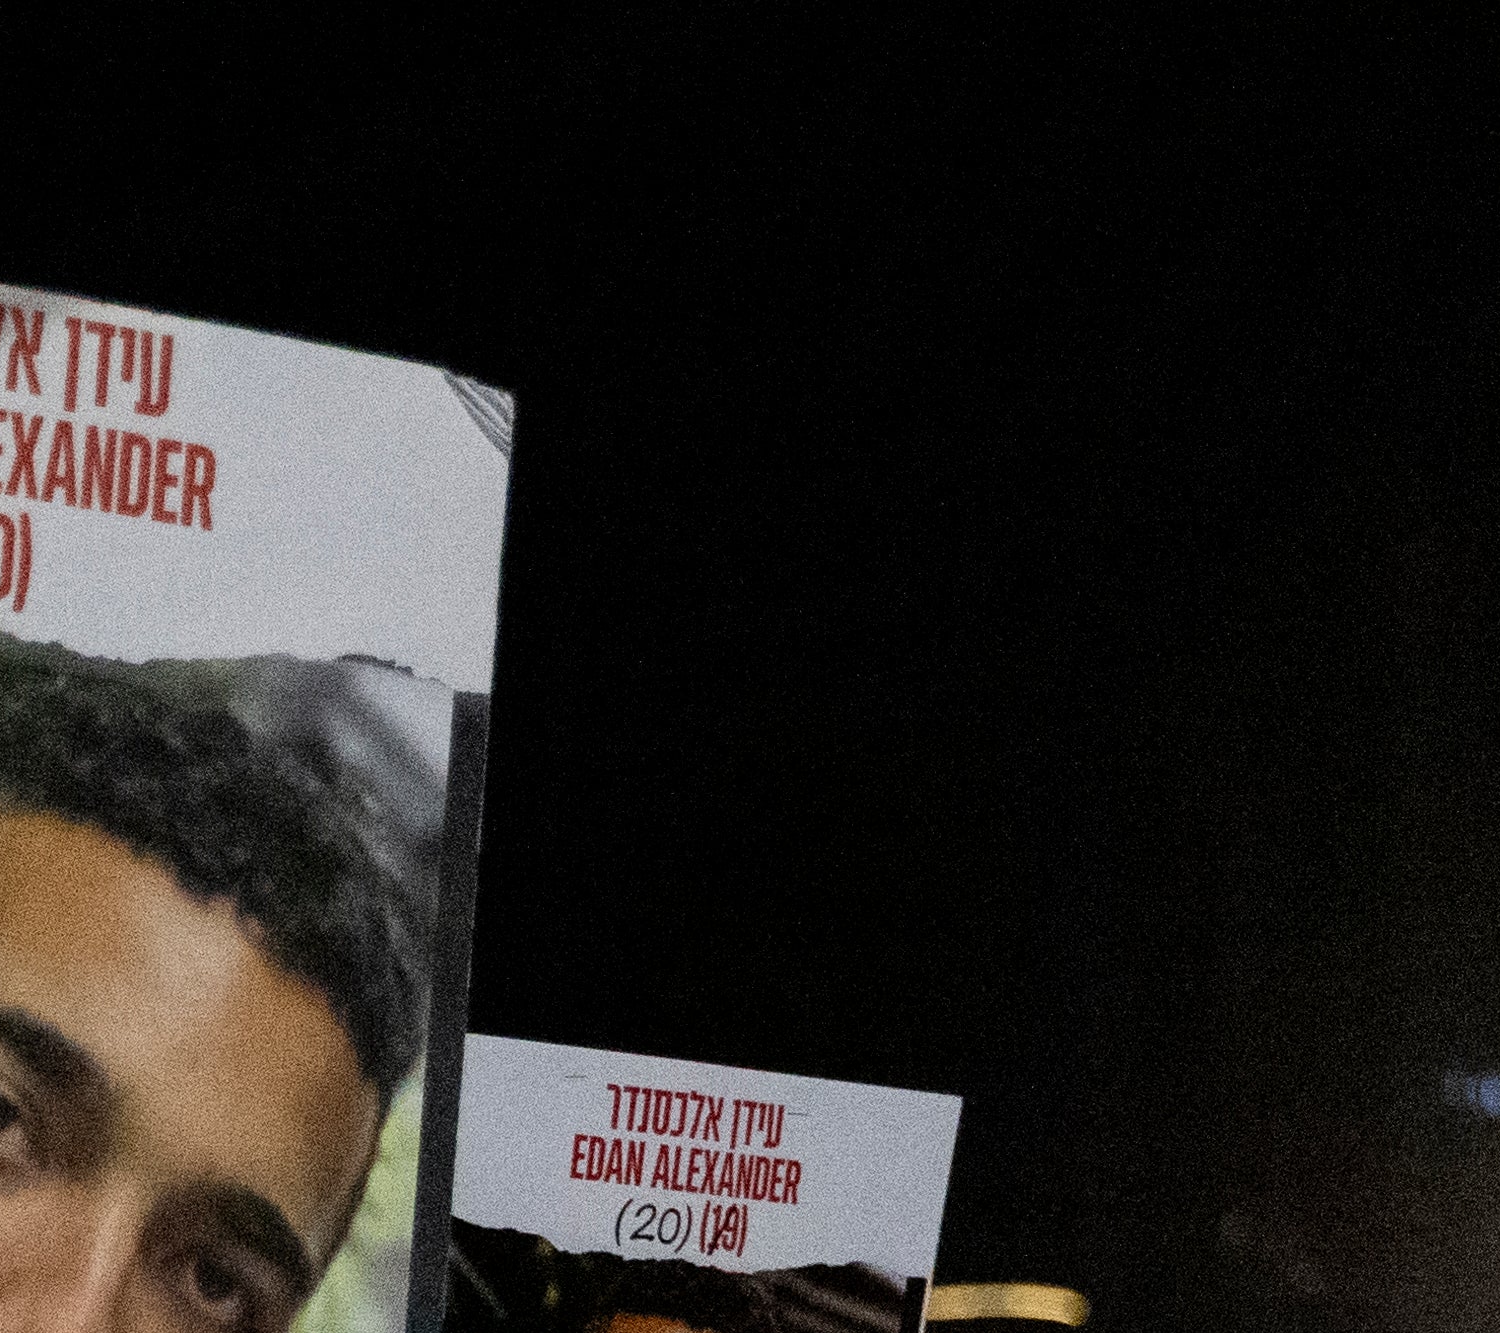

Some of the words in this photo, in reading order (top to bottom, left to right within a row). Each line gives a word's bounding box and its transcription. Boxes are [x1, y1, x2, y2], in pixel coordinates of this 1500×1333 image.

[64, 317, 174, 417] עידן
[607, 1083, 724, 1142] אלכסנדר
[730, 1099, 785, 1150] עידן
[570, 1133, 645, 1187] EDAN
[651, 1144, 801, 1205] ALEXANDER
[615, 1199, 692, 1253] (20)
